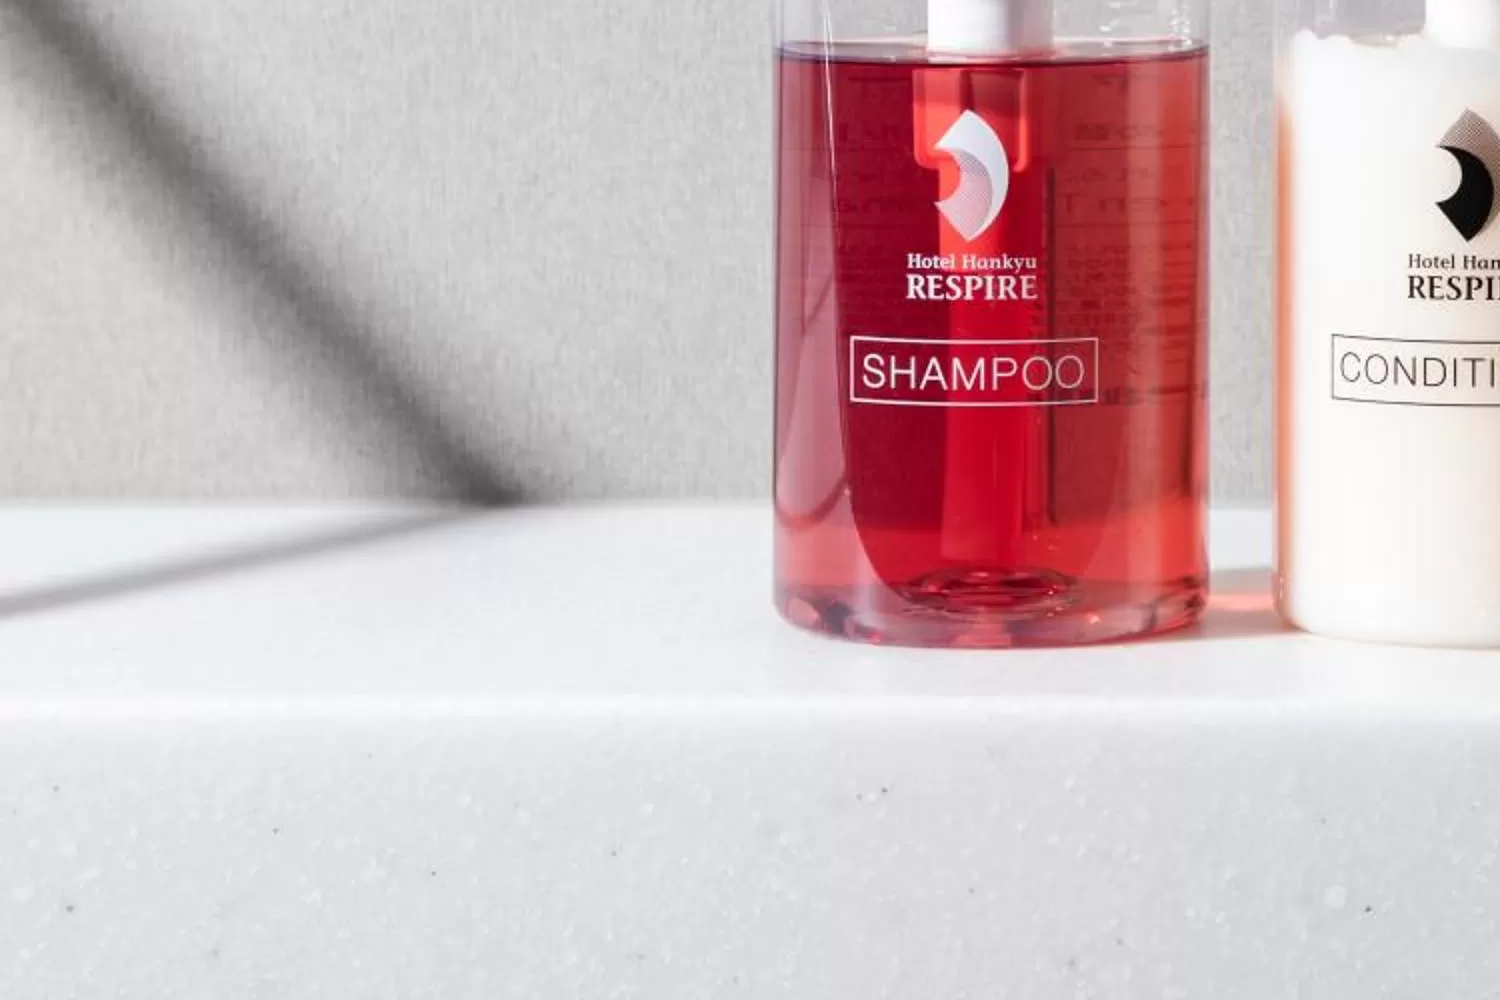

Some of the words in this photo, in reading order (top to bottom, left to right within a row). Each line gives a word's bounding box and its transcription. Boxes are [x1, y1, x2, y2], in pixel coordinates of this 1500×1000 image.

[907, 253, 955, 270] Hotel
[962, 253, 1037, 274] Hankyu
[1408, 253, 1456, 270] Hotel
[906, 274, 1038, 300] RESPIRE
[862, 353, 1085, 391] SHAMPOO
